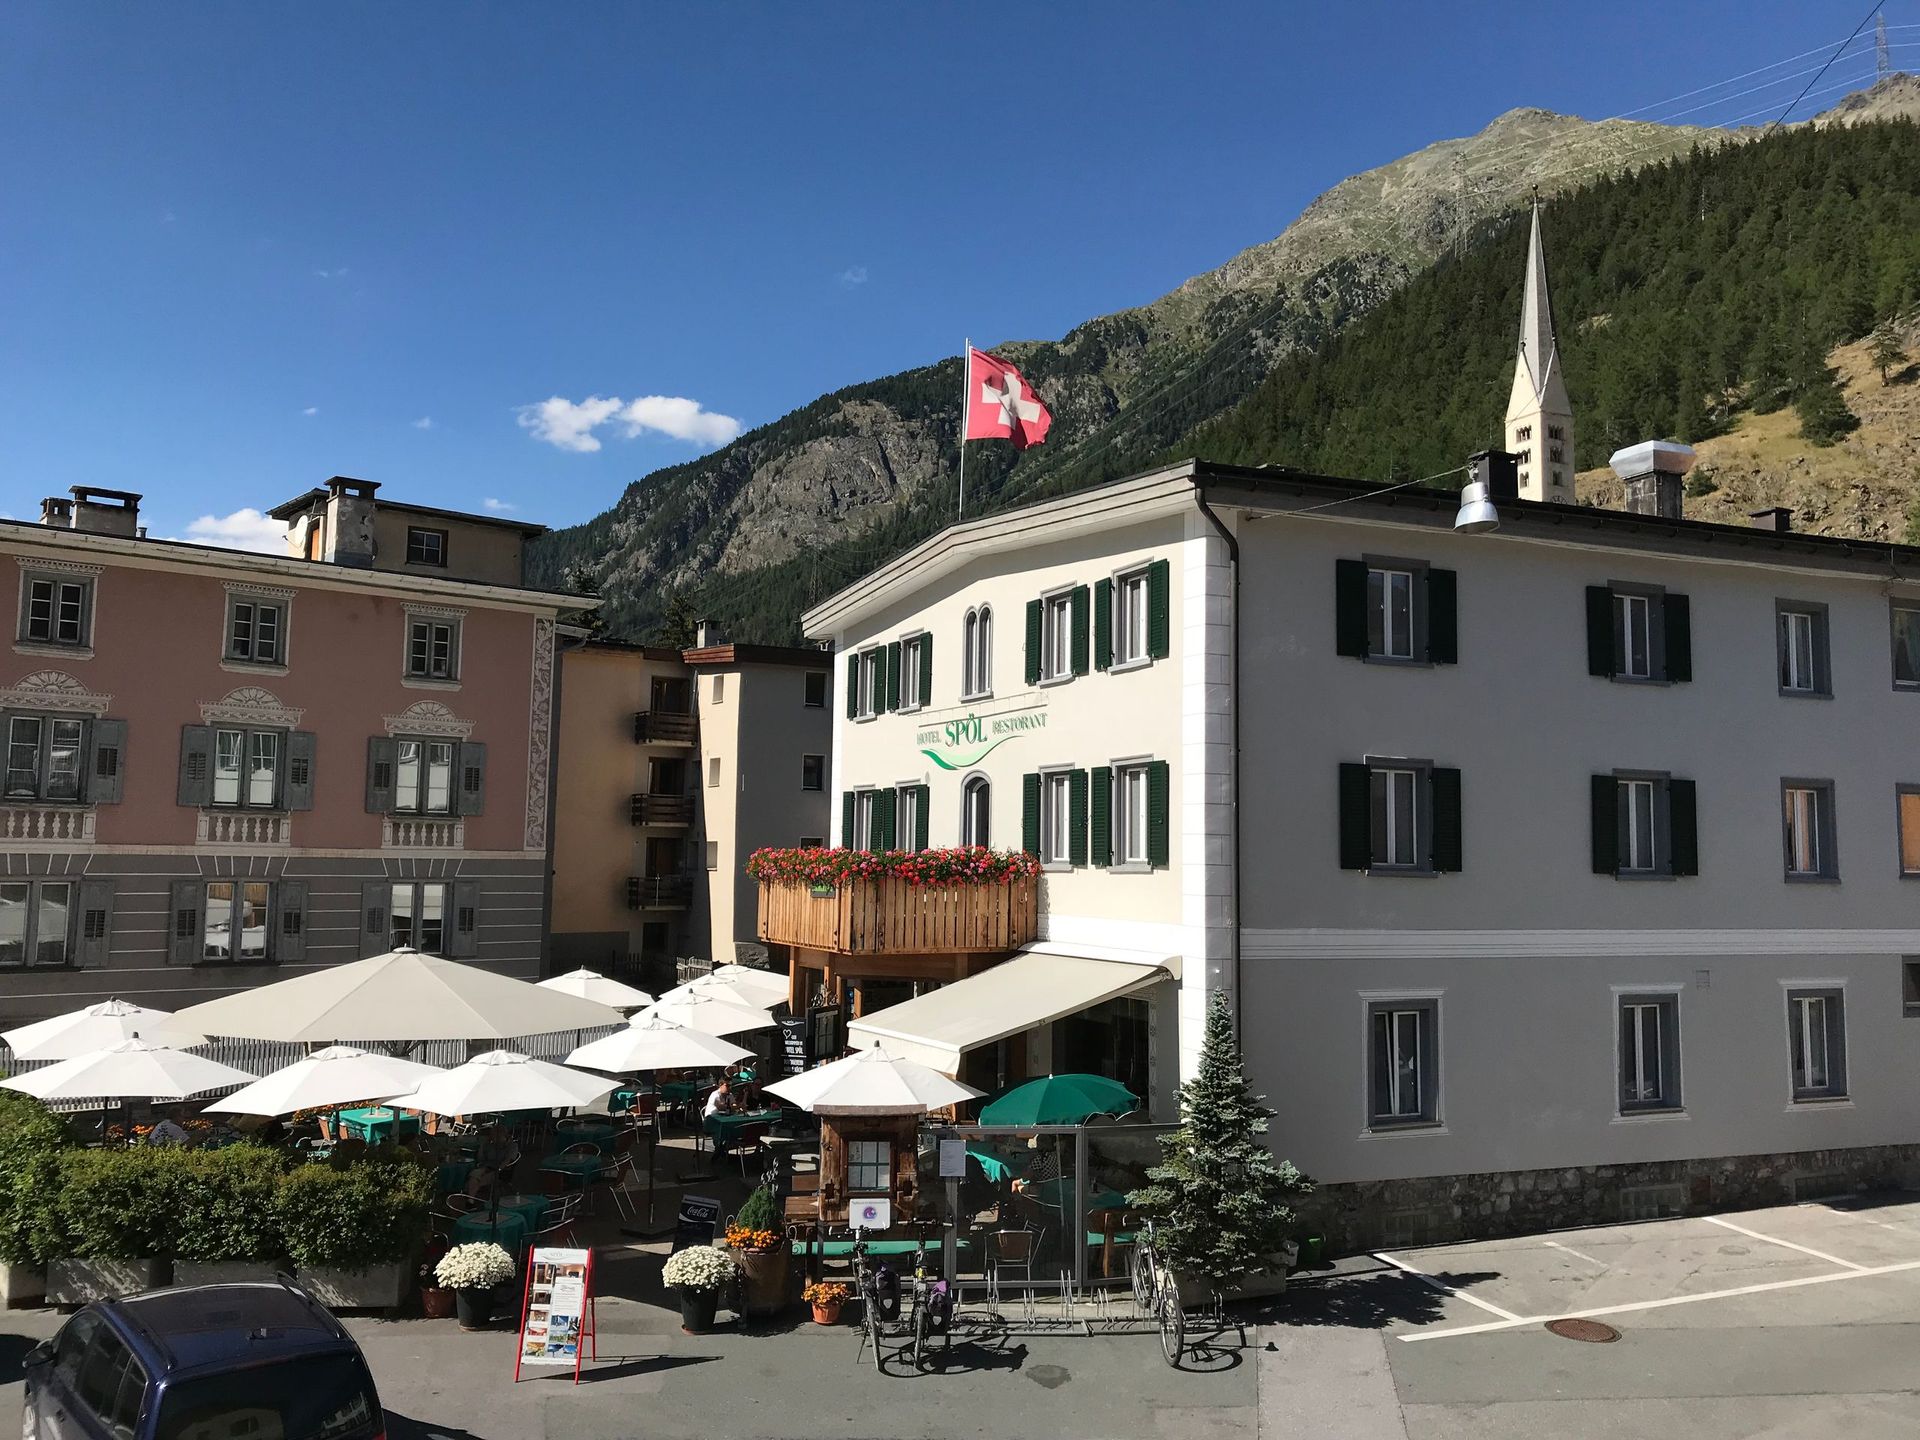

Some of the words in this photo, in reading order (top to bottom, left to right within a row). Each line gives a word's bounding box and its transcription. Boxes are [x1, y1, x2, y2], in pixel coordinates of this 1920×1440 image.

[917, 731, 941, 745] HOTEL
[945, 713, 987, 747] SPÖL
[992, 713, 1047, 734] RESTORANT
